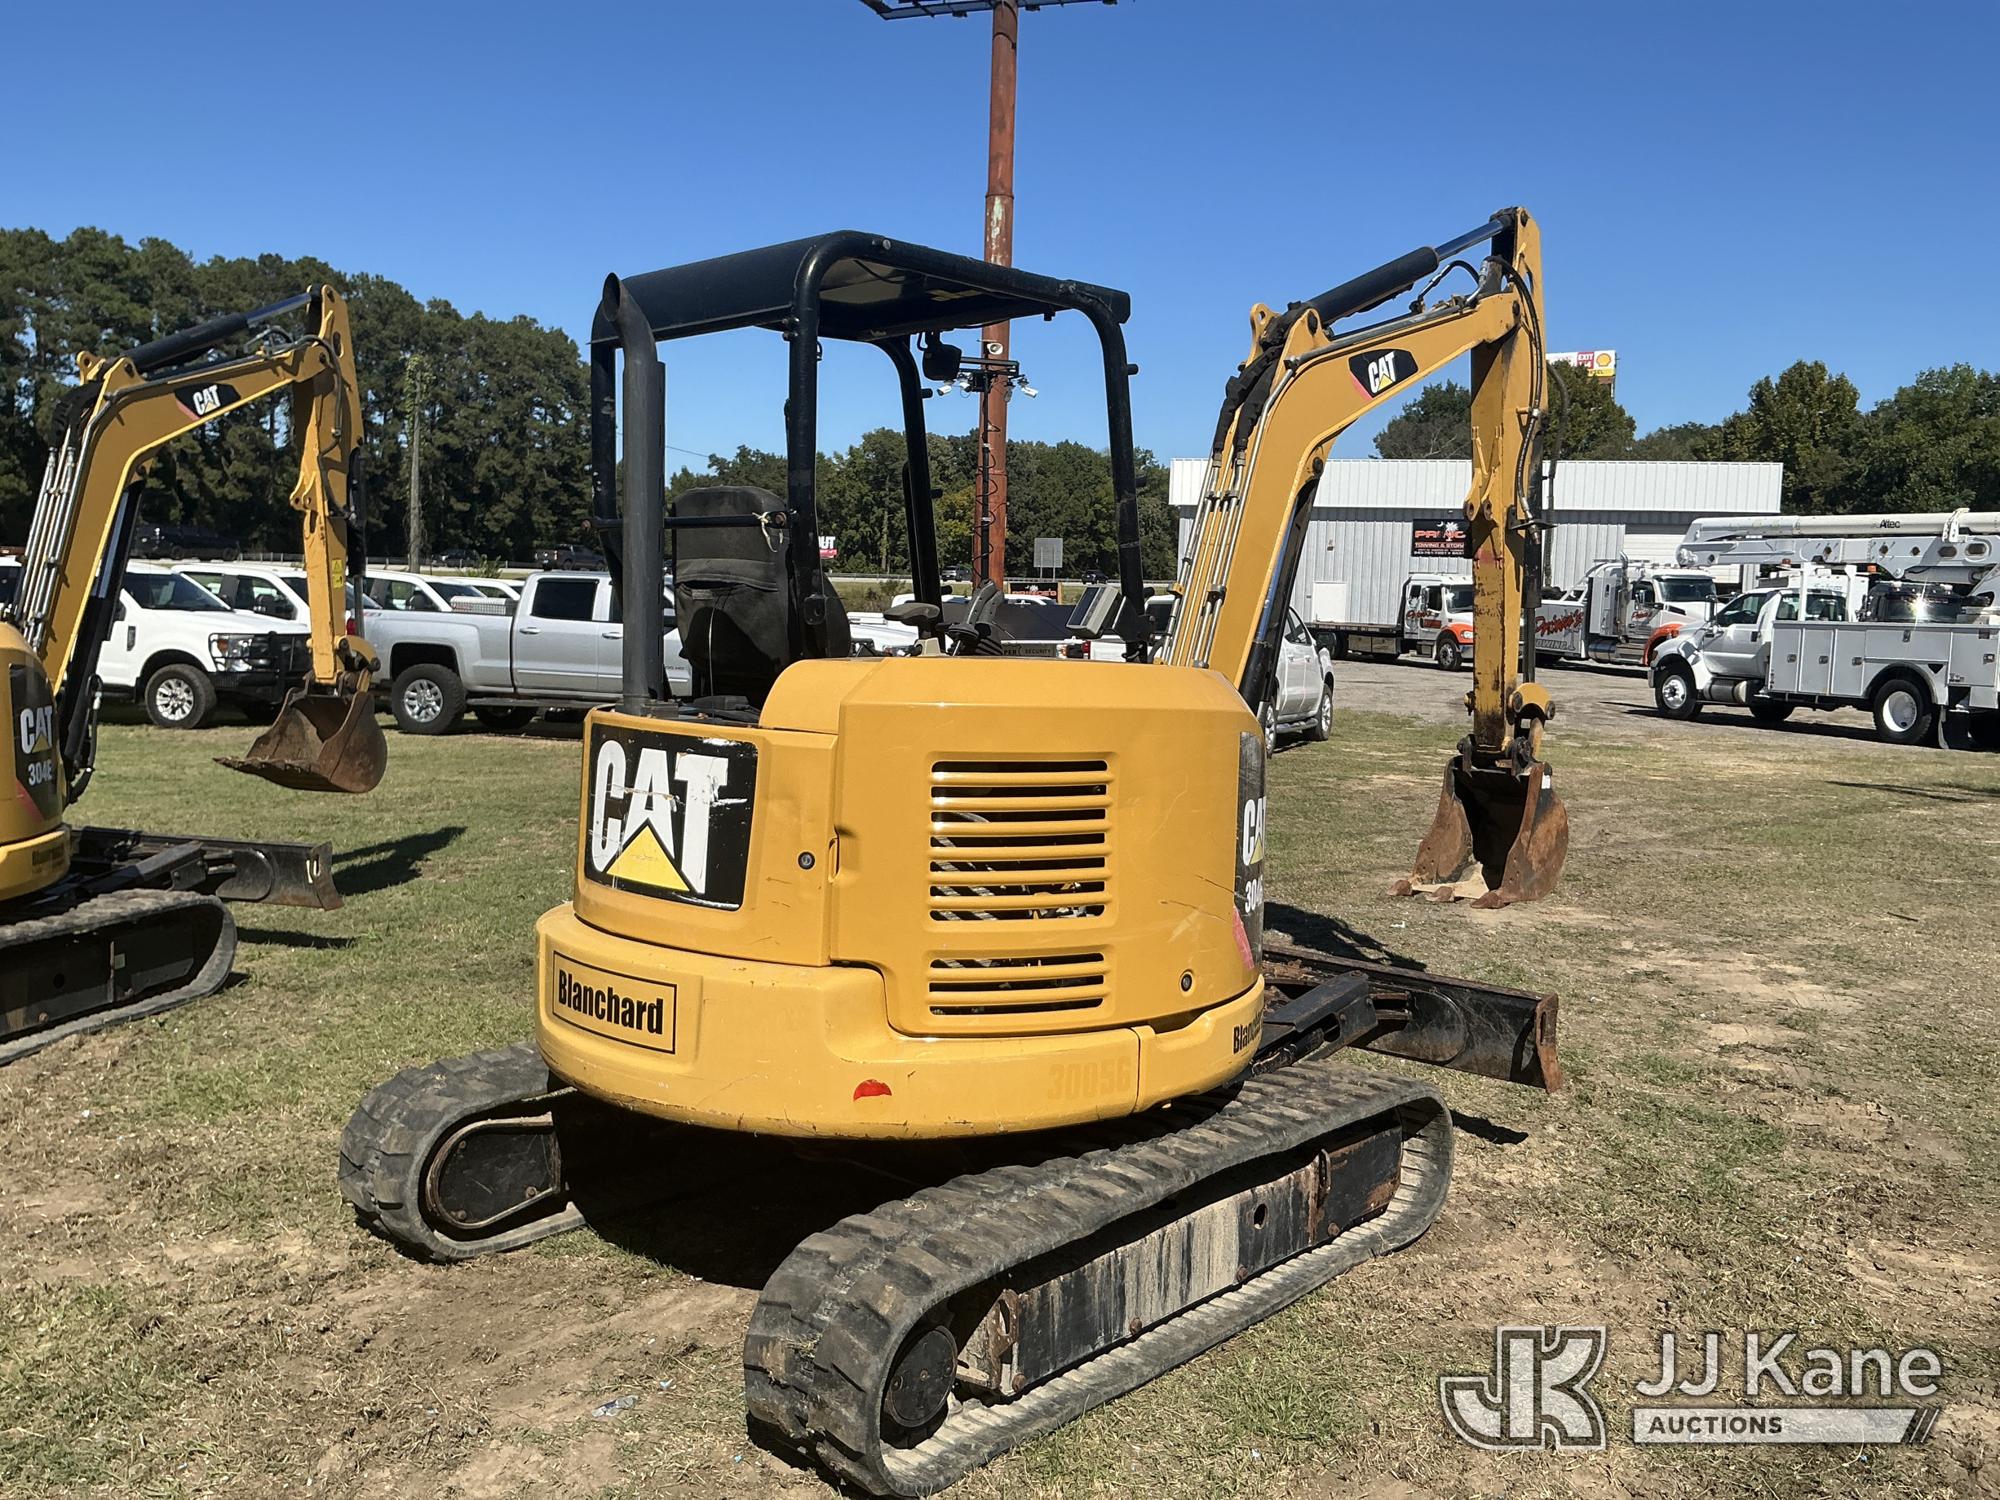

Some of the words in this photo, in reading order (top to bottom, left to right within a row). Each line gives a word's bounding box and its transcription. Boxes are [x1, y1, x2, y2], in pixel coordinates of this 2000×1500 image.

[1368, 351, 1396, 394] CAT
[193, 384, 221, 416] CAT
[1880, 519, 1900, 528] Altec
[1535, 640, 1567, 651] OWING
[20, 706, 53, 755] CAT
[28, 760, 53, 786] 304E
[591, 739, 729, 895] CAT
[558, 968, 664, 1036] Blanchard
